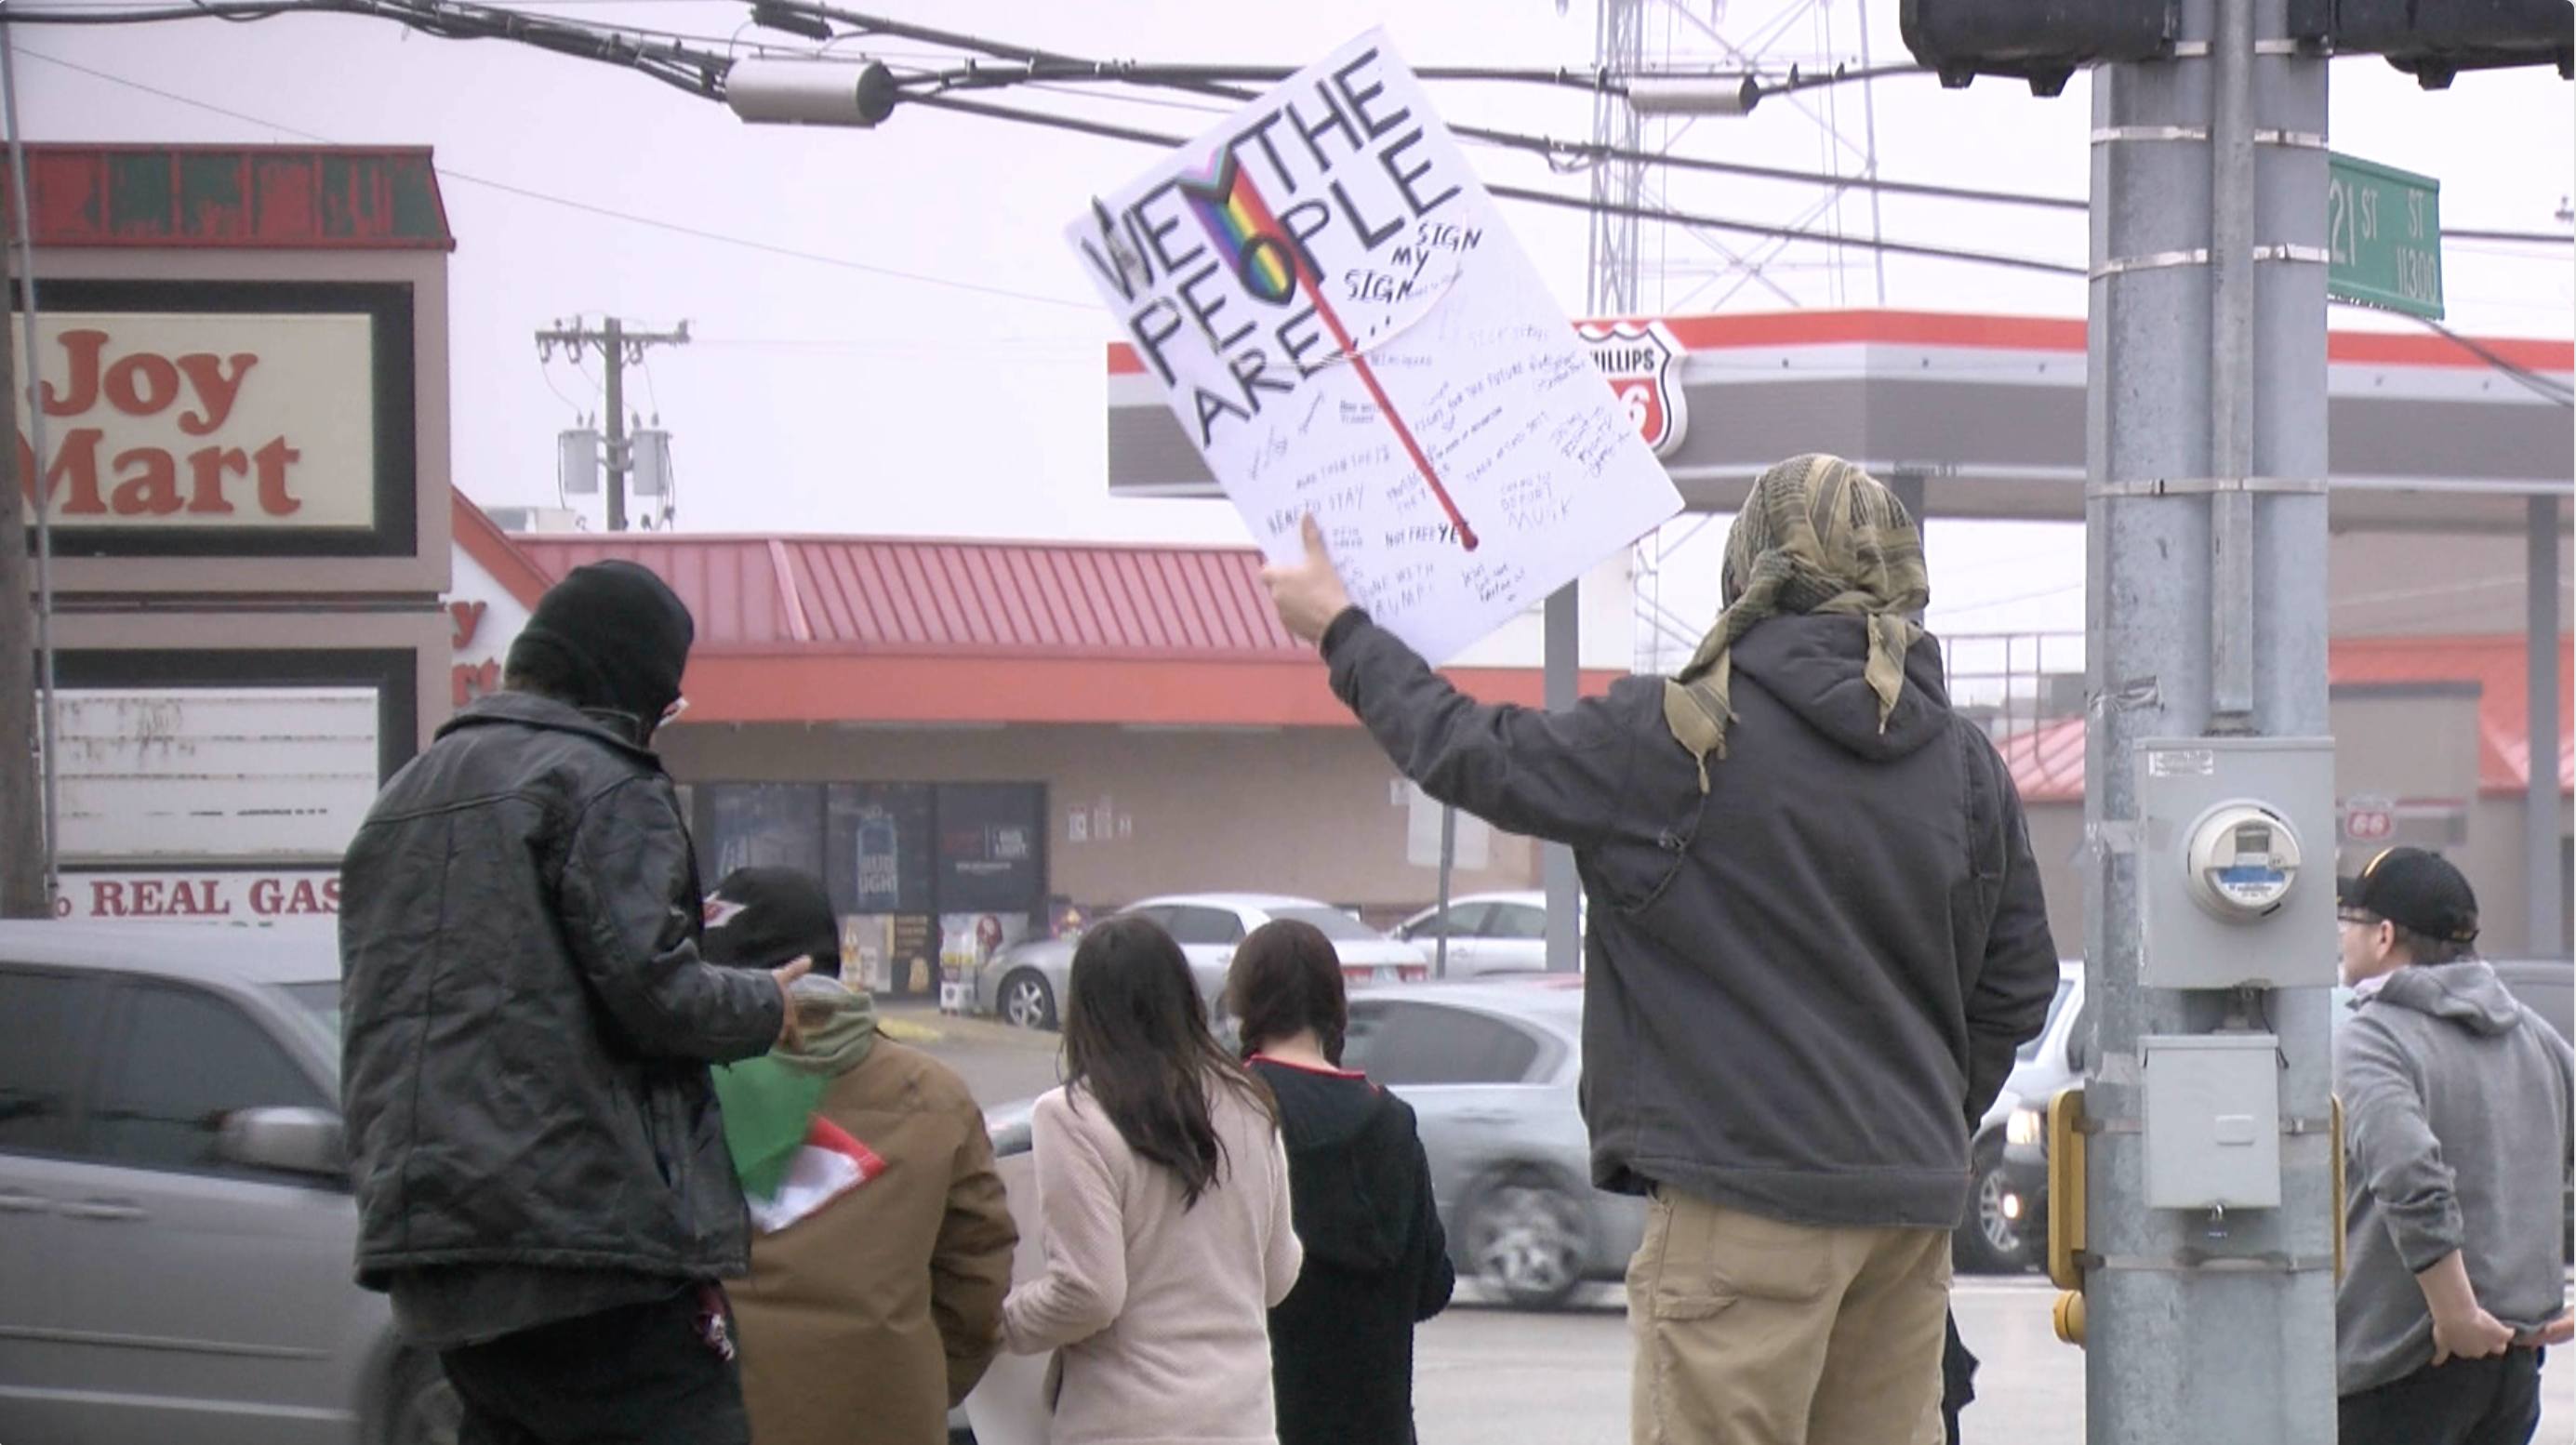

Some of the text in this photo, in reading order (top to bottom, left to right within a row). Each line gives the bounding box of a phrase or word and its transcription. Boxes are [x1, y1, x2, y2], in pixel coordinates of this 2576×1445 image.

[1081, 47, 1410, 302] WE THE
[1417, 223, 1482, 251] SIGN
[2409, 188, 2423, 239] ST
[1130, 127, 1462, 388] PEOPLE
[1391, 245, 1429, 278] MY
[2397, 246, 2437, 306] 11300
[1345, 269, 1414, 302] SIGN
[26, 329, 259, 436] Joy
[1194, 305, 1346, 448] ARE
[1328, 482, 1363, 510] STAY
[90, 880, 230, 917] REAL
